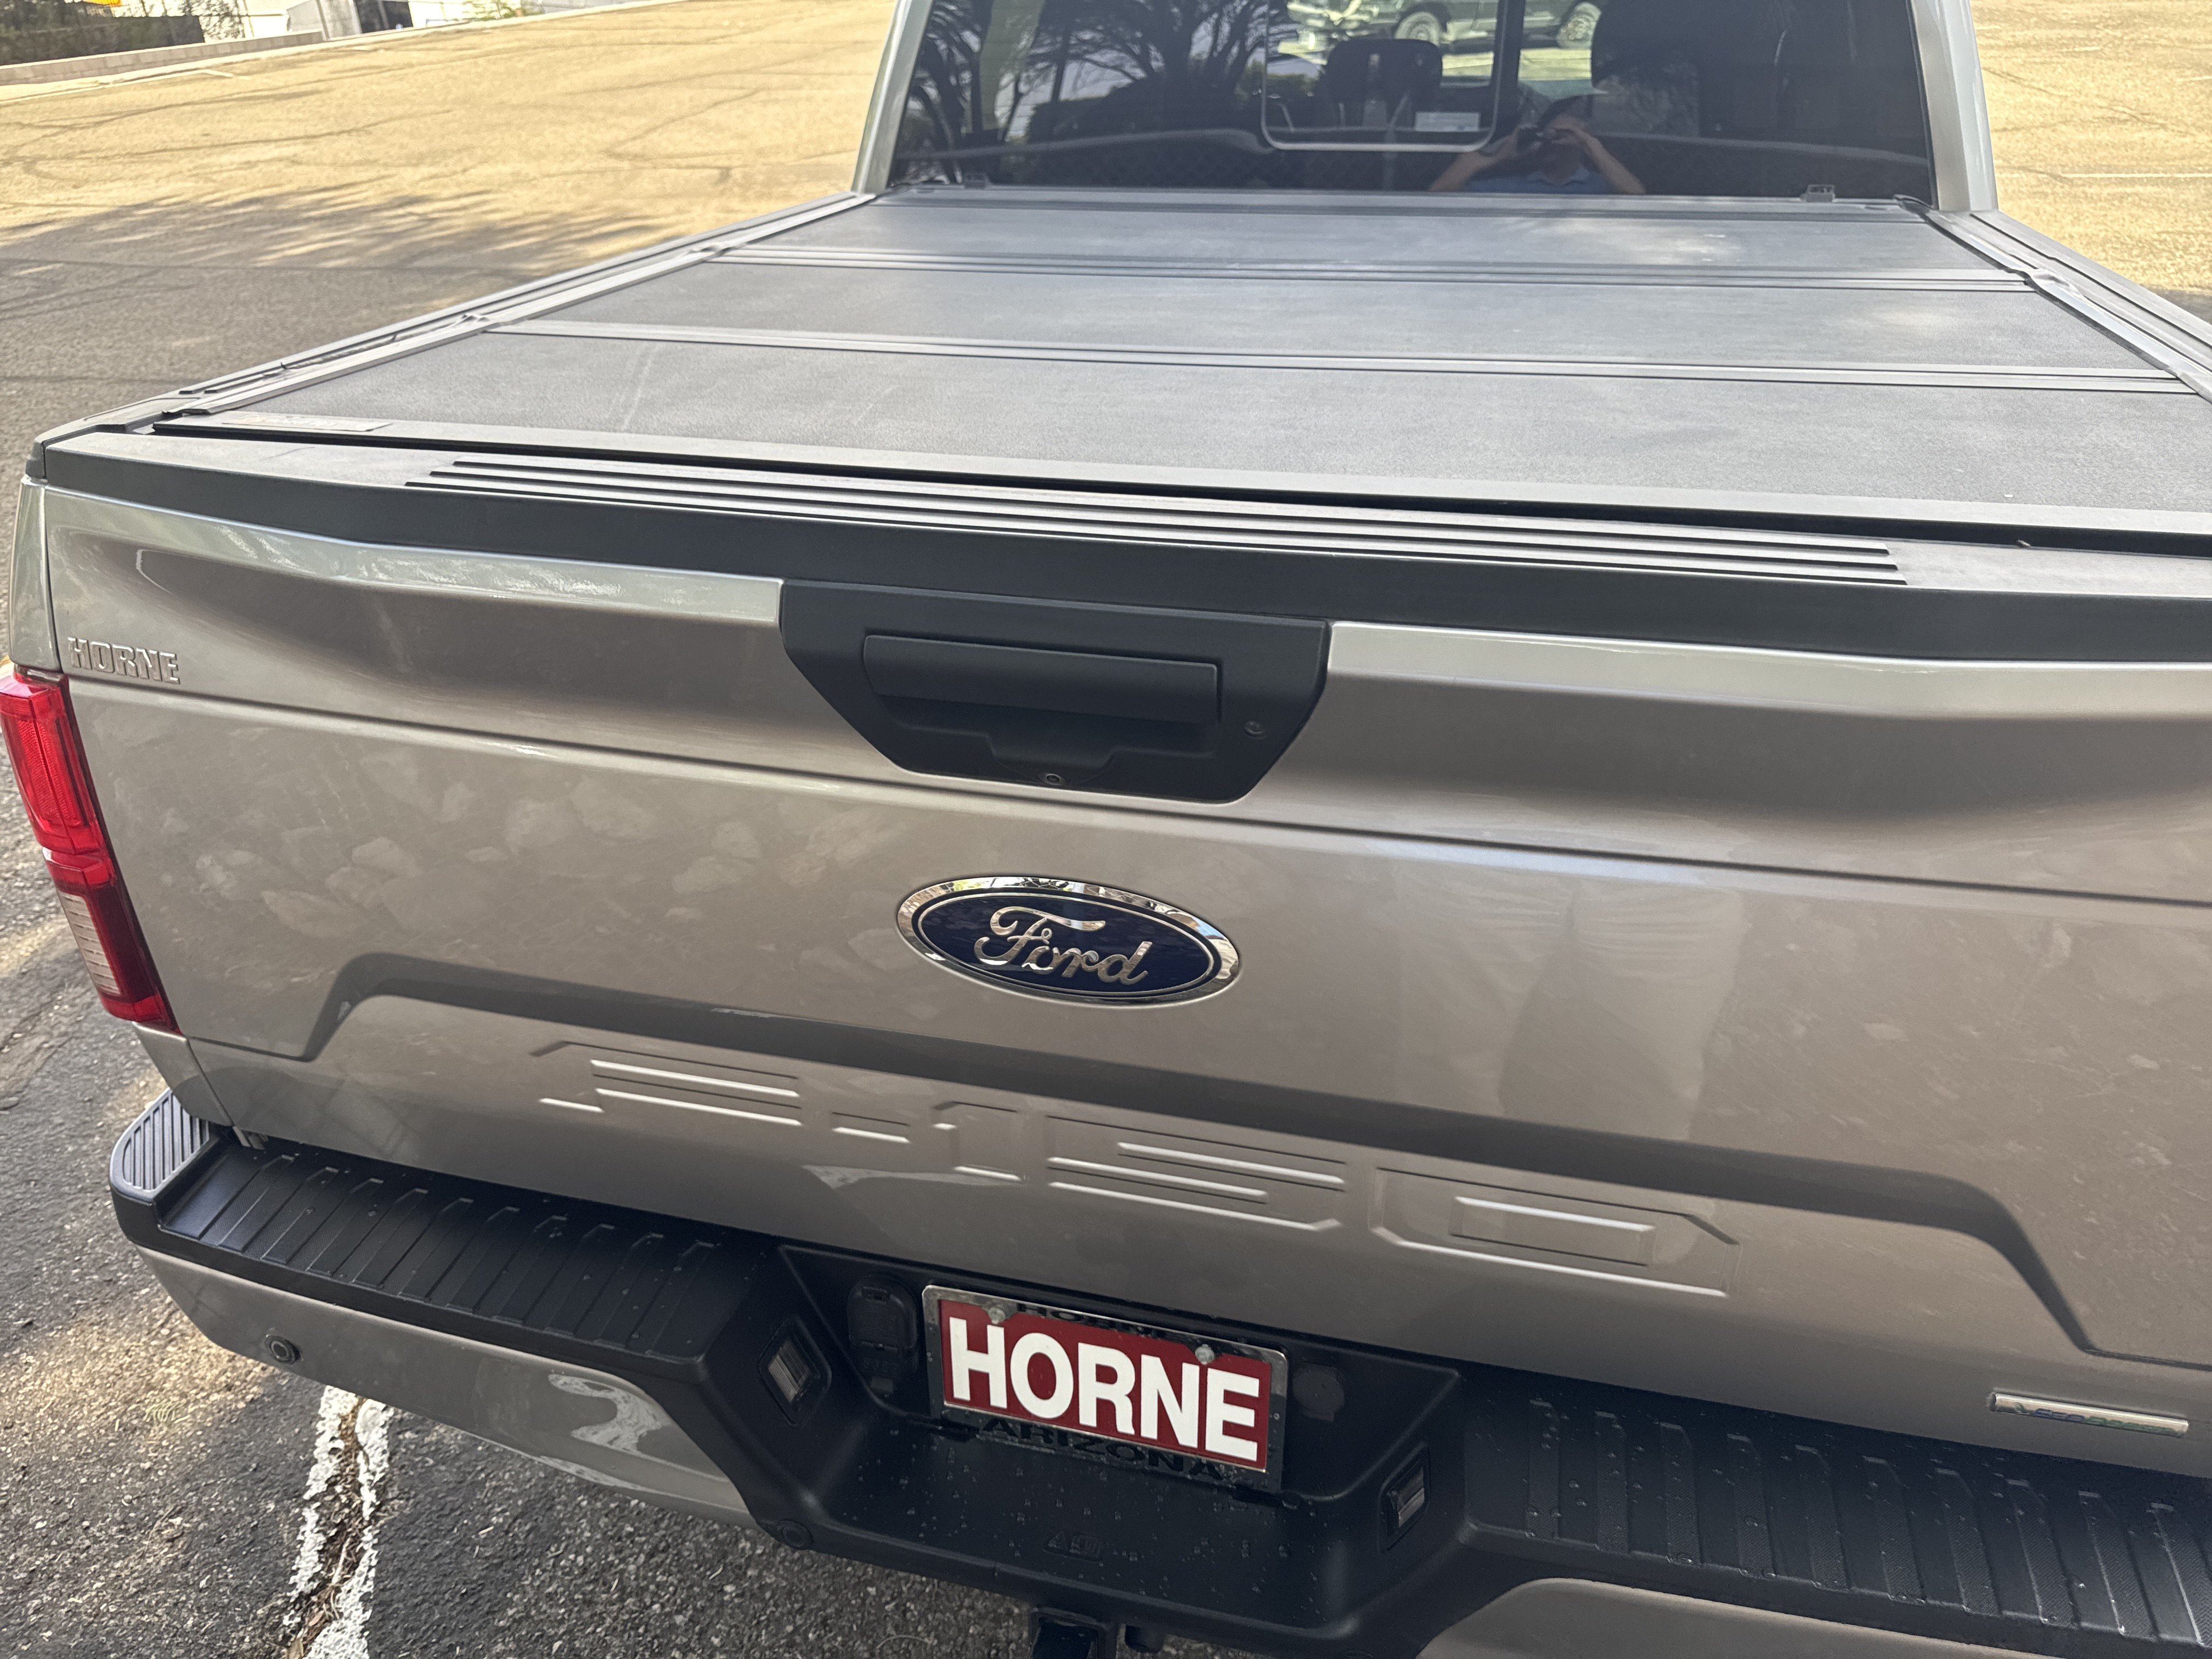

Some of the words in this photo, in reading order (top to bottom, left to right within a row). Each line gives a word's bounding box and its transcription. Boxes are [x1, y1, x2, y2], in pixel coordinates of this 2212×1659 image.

[67, 637, 181, 685] HORNE
[973, 906, 1153, 985] Ford
[530, 1041, 1741, 1297] F-150
[949, 1317, 1260, 1462] HORNE
[982, 1417, 1223, 1480] ARIZONA
